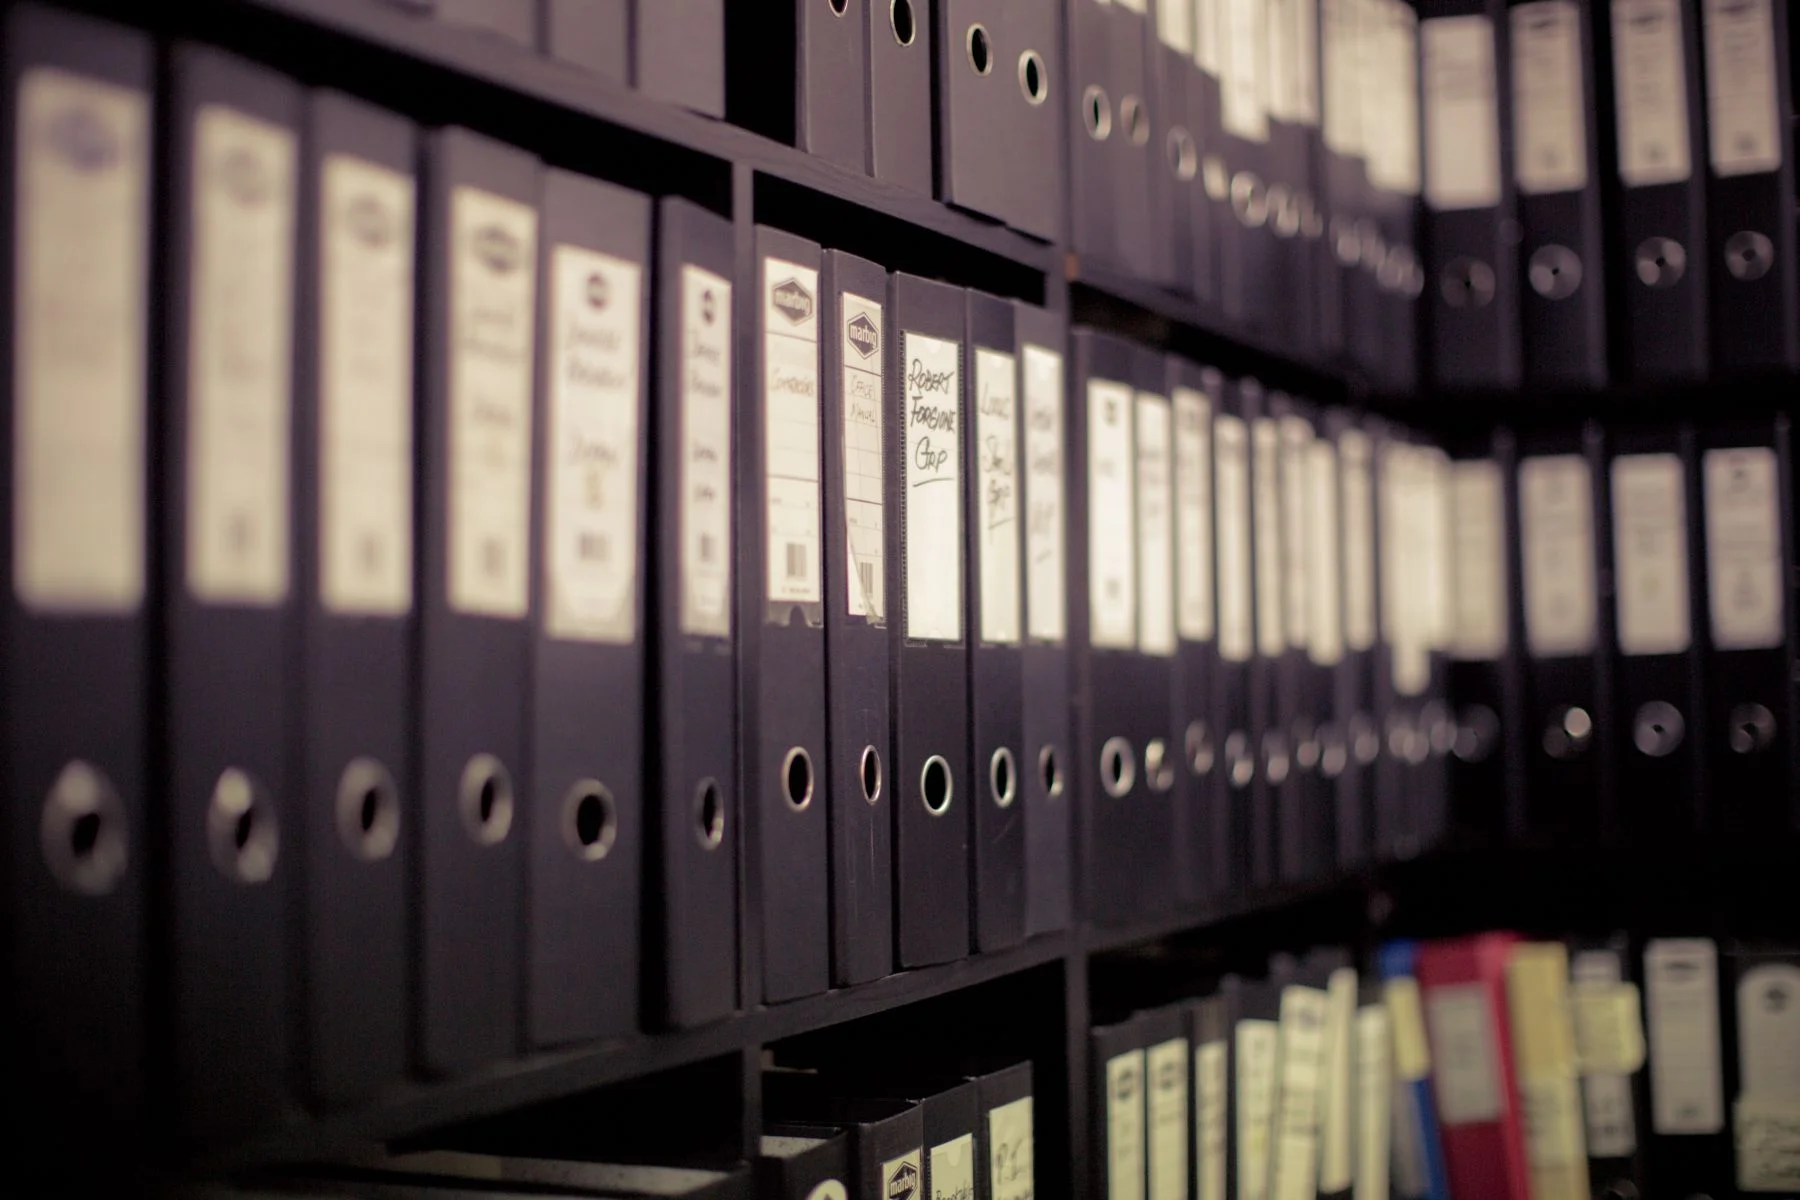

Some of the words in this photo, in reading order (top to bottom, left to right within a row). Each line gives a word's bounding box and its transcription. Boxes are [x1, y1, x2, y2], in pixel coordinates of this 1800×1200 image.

[849, 324, 878, 349] marbig
[908, 358, 955, 395] ROBERT
[890, 1171, 916, 1197] marbig
